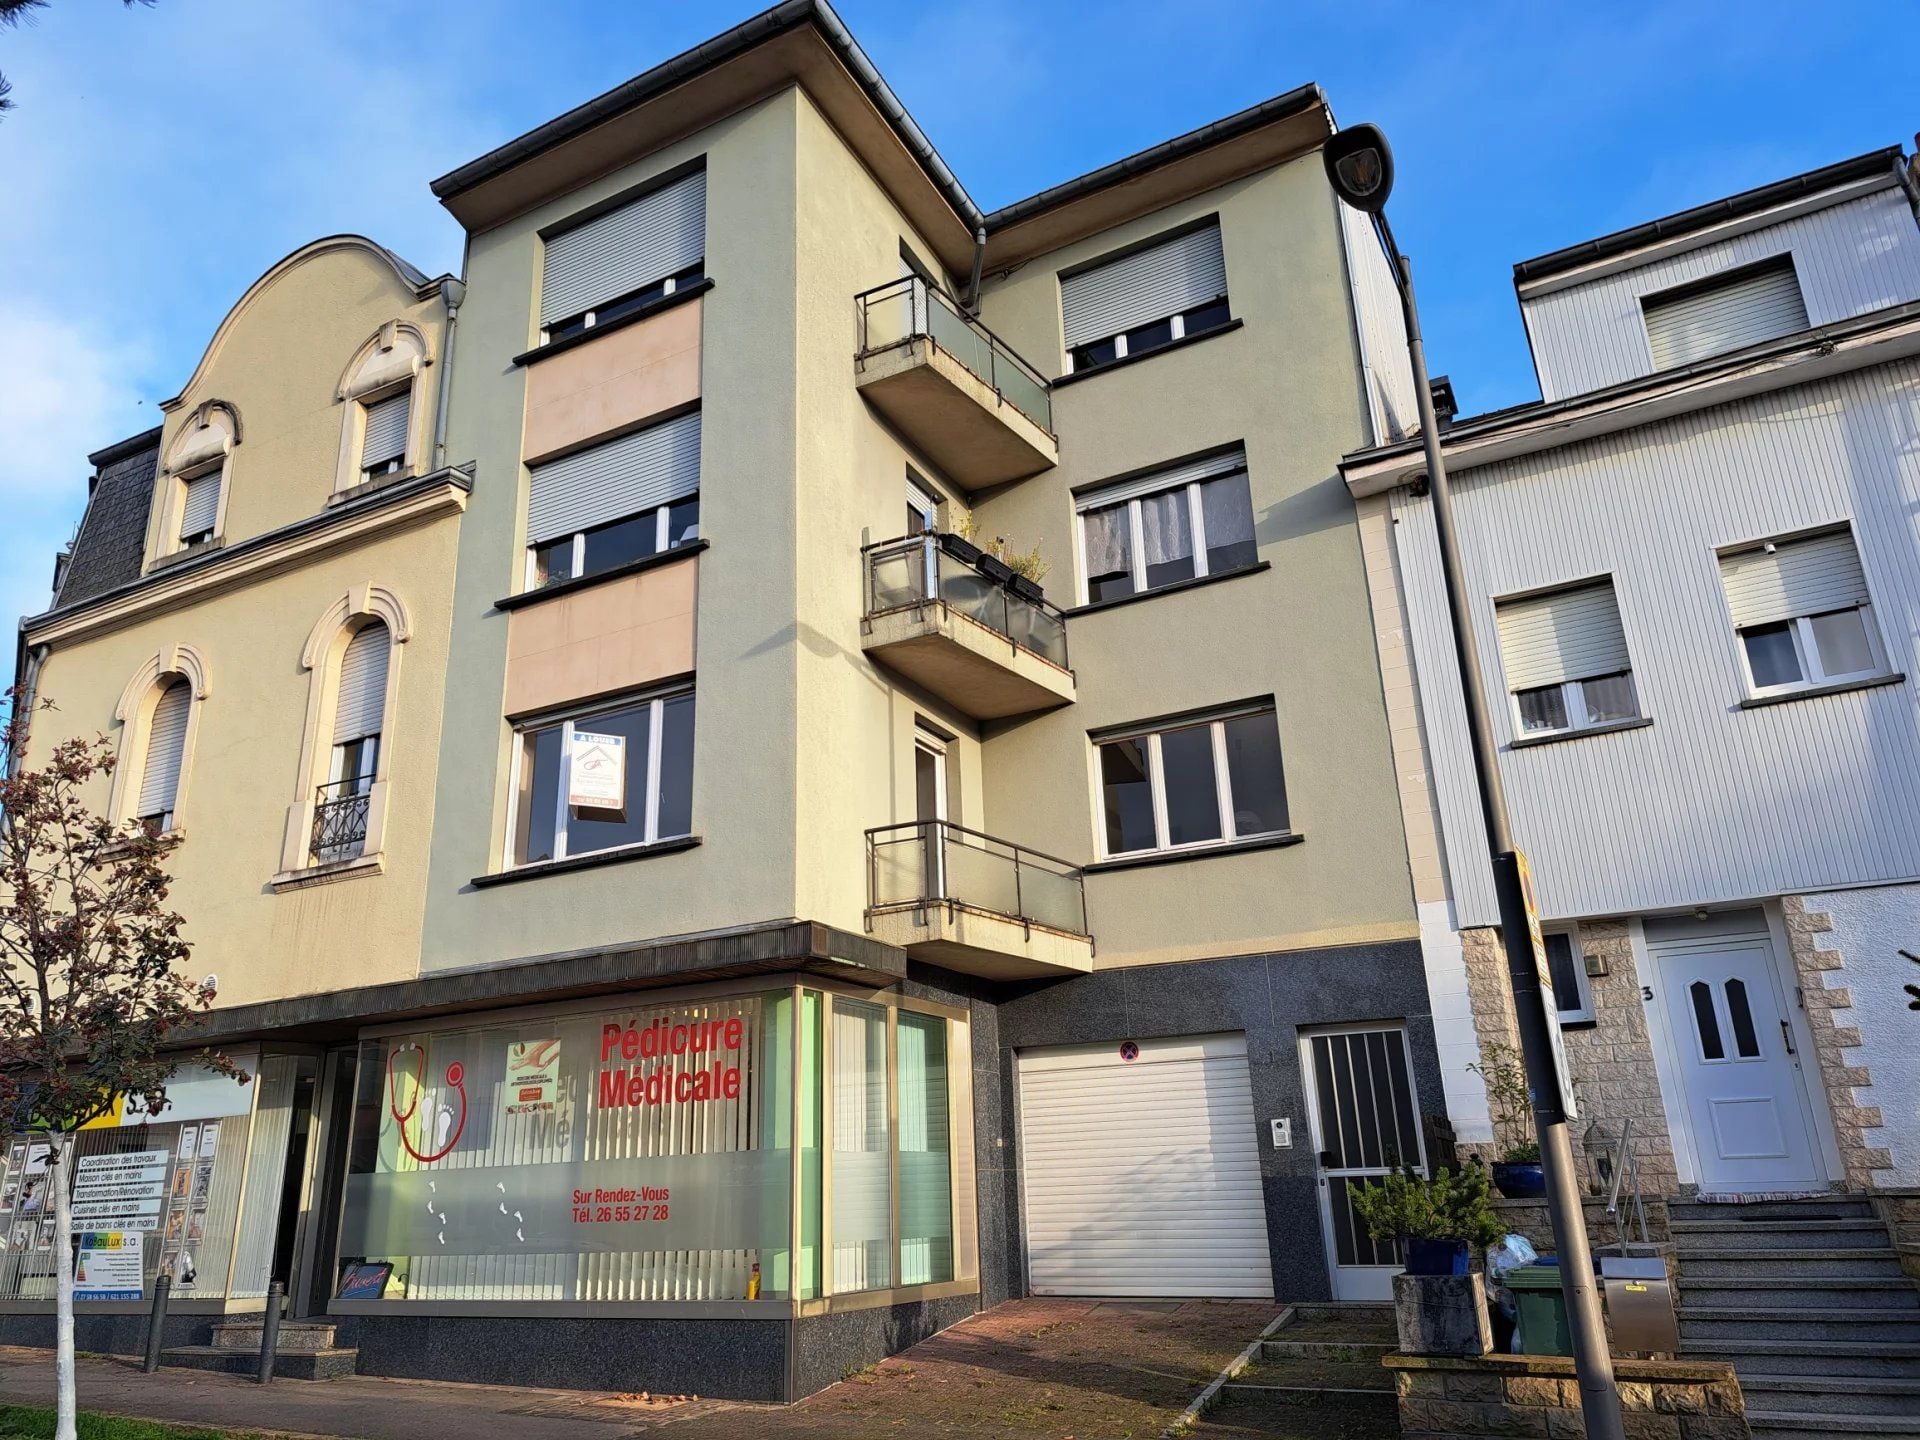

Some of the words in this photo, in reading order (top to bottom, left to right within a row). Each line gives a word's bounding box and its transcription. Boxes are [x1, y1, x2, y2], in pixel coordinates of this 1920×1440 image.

[601, 1017, 743, 1062] Pédicure
[599, 1061, 741, 1109] Médicale
[81, 1157, 120, 1167] Coordination
[121, 1156, 132, 1164] des
[134, 1154, 157, 1162] travaux
[79, 1174, 99, 1182] Maison
[101, 1173, 113, 1181] clés
[124, 1171, 142, 1179] mains
[573, 1189, 592, 1204] Sur
[595, 1186, 669, 1203] Rendez-Vous
[73, 1205, 97, 1214] Cuisines
[99, 1204, 110, 1213] clés
[122, 1203, 140, 1211] mains
[572, 1206, 593, 1223] Tél.
[596, 1207, 611, 1222] 26
[615, 1206, 630, 1221] 55
[634, 1205, 649, 1220] 27
[652, 1204, 669, 1220] 28
[85, 1221, 94, 1230] de
[113, 1219, 126, 1228] clés
